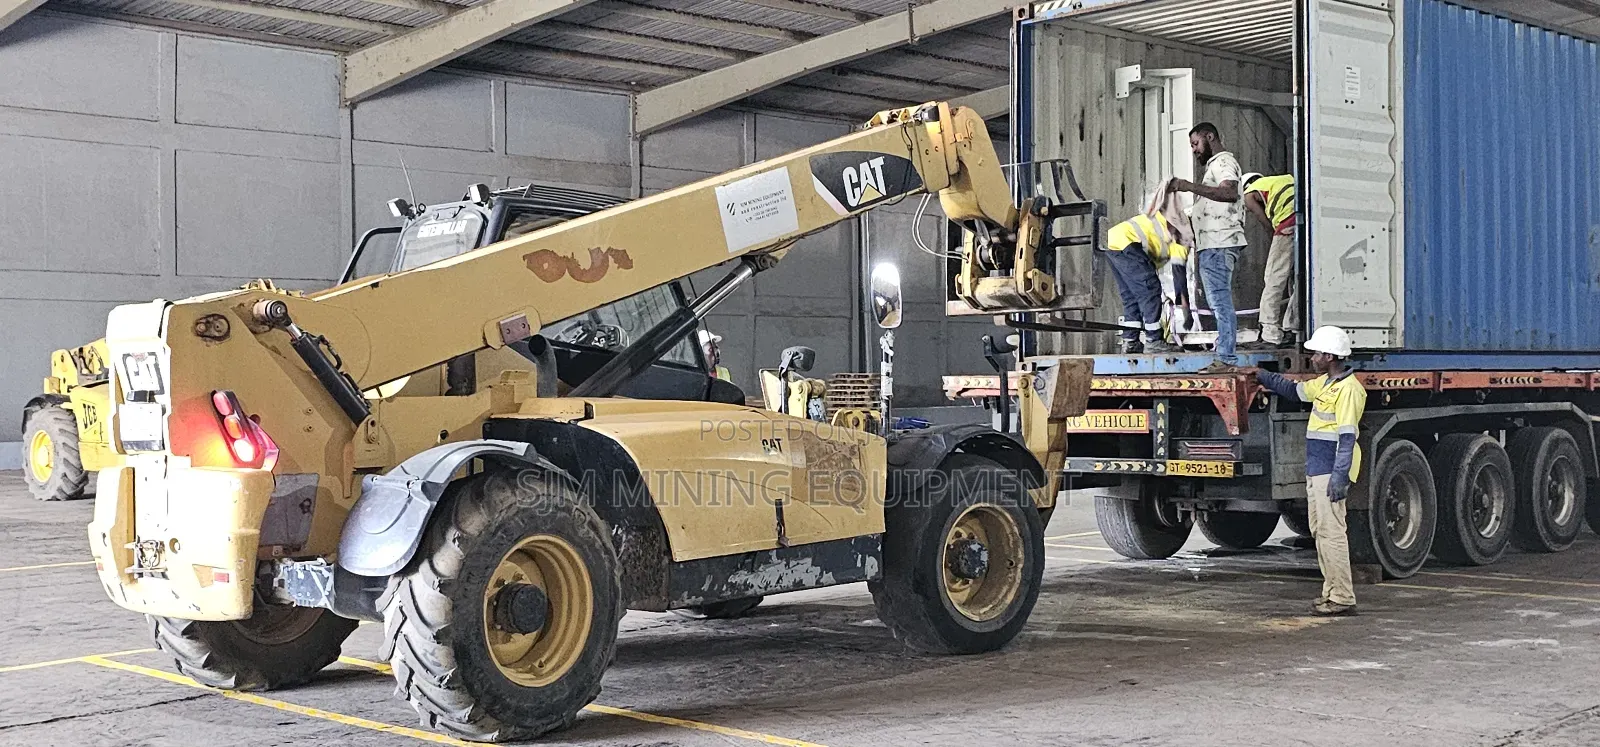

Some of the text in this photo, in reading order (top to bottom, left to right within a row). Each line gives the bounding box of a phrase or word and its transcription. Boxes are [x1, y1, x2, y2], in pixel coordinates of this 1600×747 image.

[842, 156, 887, 207] CAT
[82, 403, 98, 430] JCB
[1086, 414, 1145, 429] VEHICLE
[761, 437, 783, 453] CAT
[1169, 462, 1180, 473] GT
